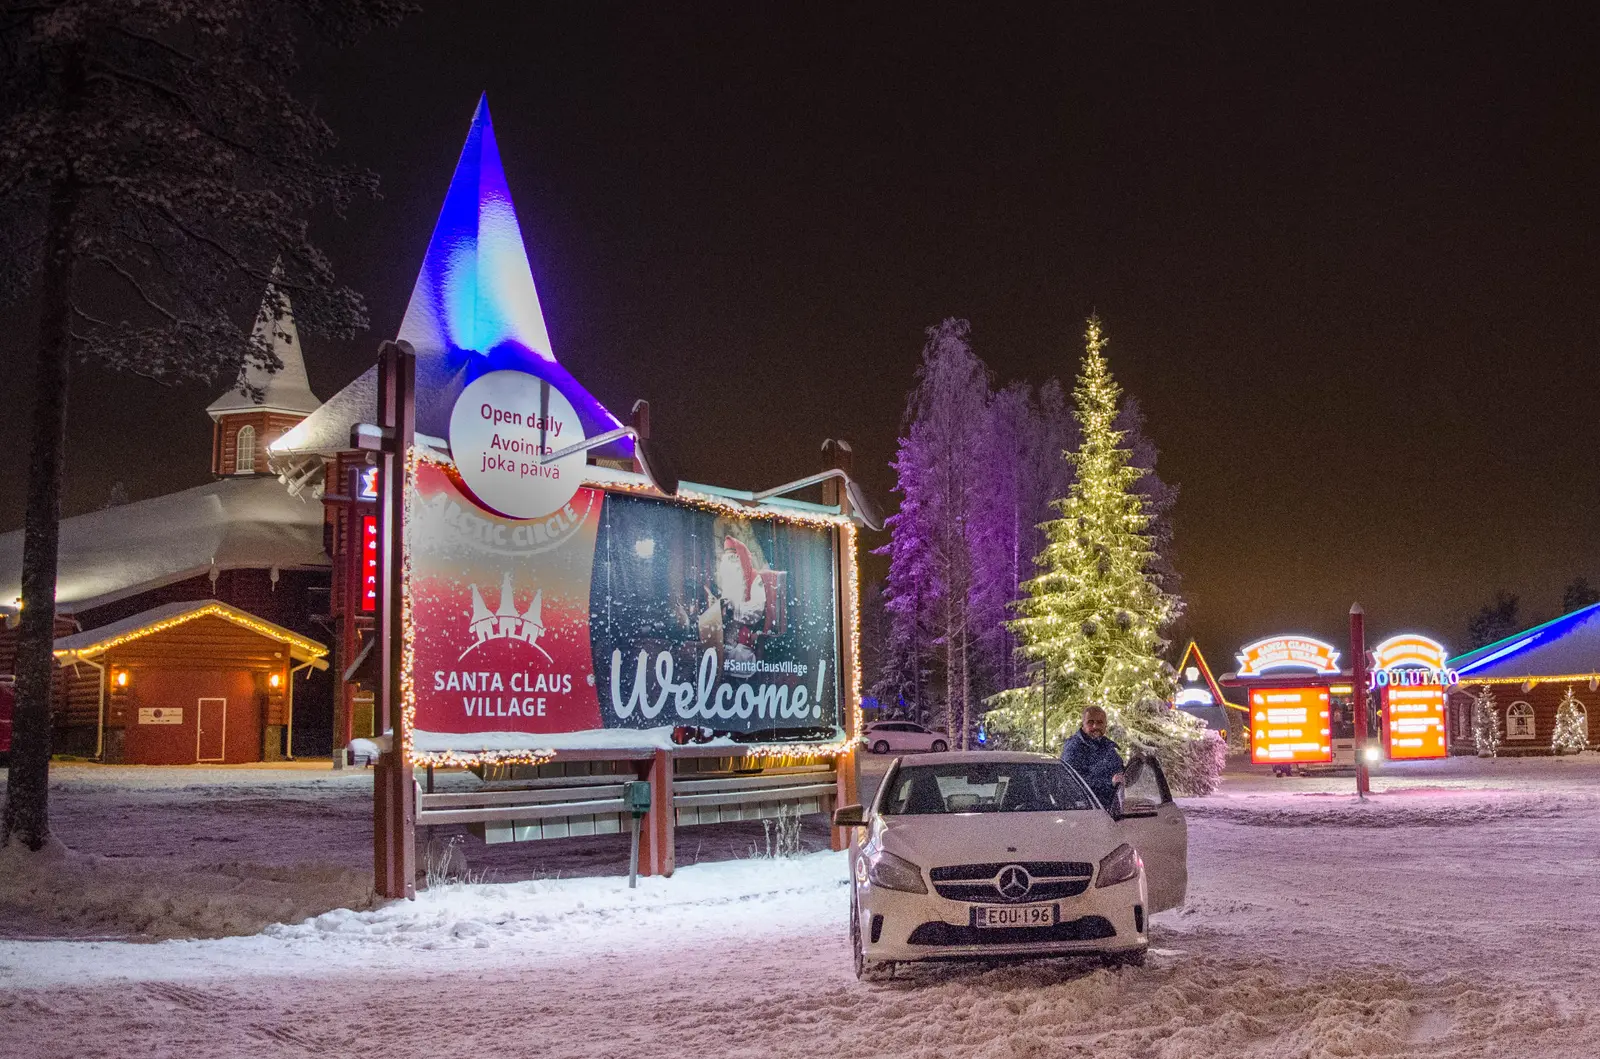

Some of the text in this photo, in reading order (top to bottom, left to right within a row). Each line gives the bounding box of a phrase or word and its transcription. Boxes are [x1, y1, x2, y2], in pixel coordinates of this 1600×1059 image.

[481, 403, 563, 437] Open daily
[490, 433, 553, 456] Avoinna
[481, 452, 560, 479] joka päivä
[511, 503, 578, 547] CIRCLE
[723, 658, 808, 677] #SantaClausVillage
[434, 670, 572, 693] SANTA CLAUS
[611, 648, 827, 719] Welcome!
[1369, 669, 1460, 691] JOULUTALO
[463, 697, 547, 717] VILLAGE
[988, 908, 1050, 924] EOU-196
